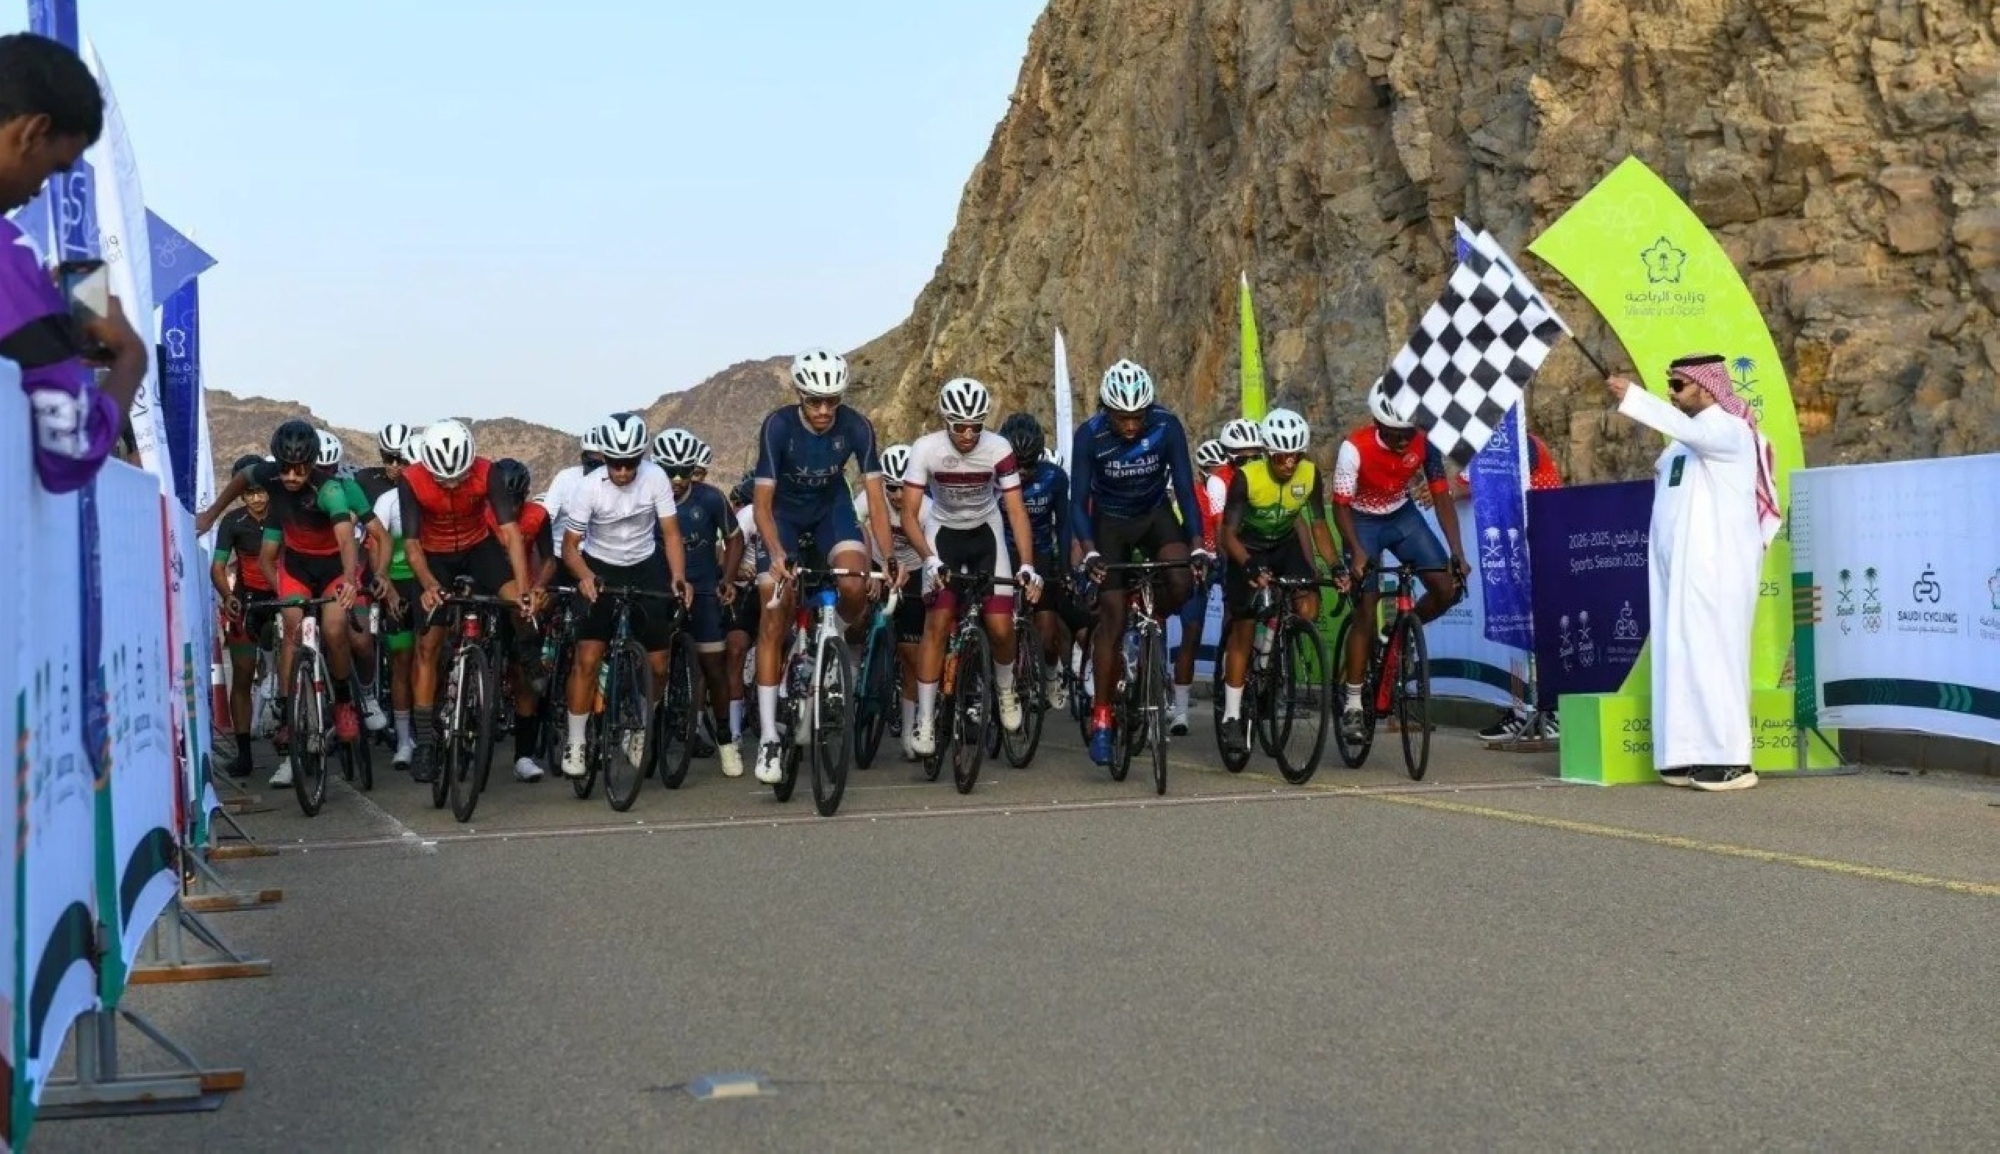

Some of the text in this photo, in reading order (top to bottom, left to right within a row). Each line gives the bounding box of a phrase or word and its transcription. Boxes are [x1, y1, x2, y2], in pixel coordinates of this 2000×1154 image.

[1481, 557, 1506, 568] Saudi
[1570, 552, 1649, 575] Sports Season 2025-
[1760, 582, 1780, 596] 25
[1863, 602, 1882, 615] Saudi
[1898, 610, 1957, 624] SAUDI CYCLING
[1622, 740, 1652, 756] Spo
